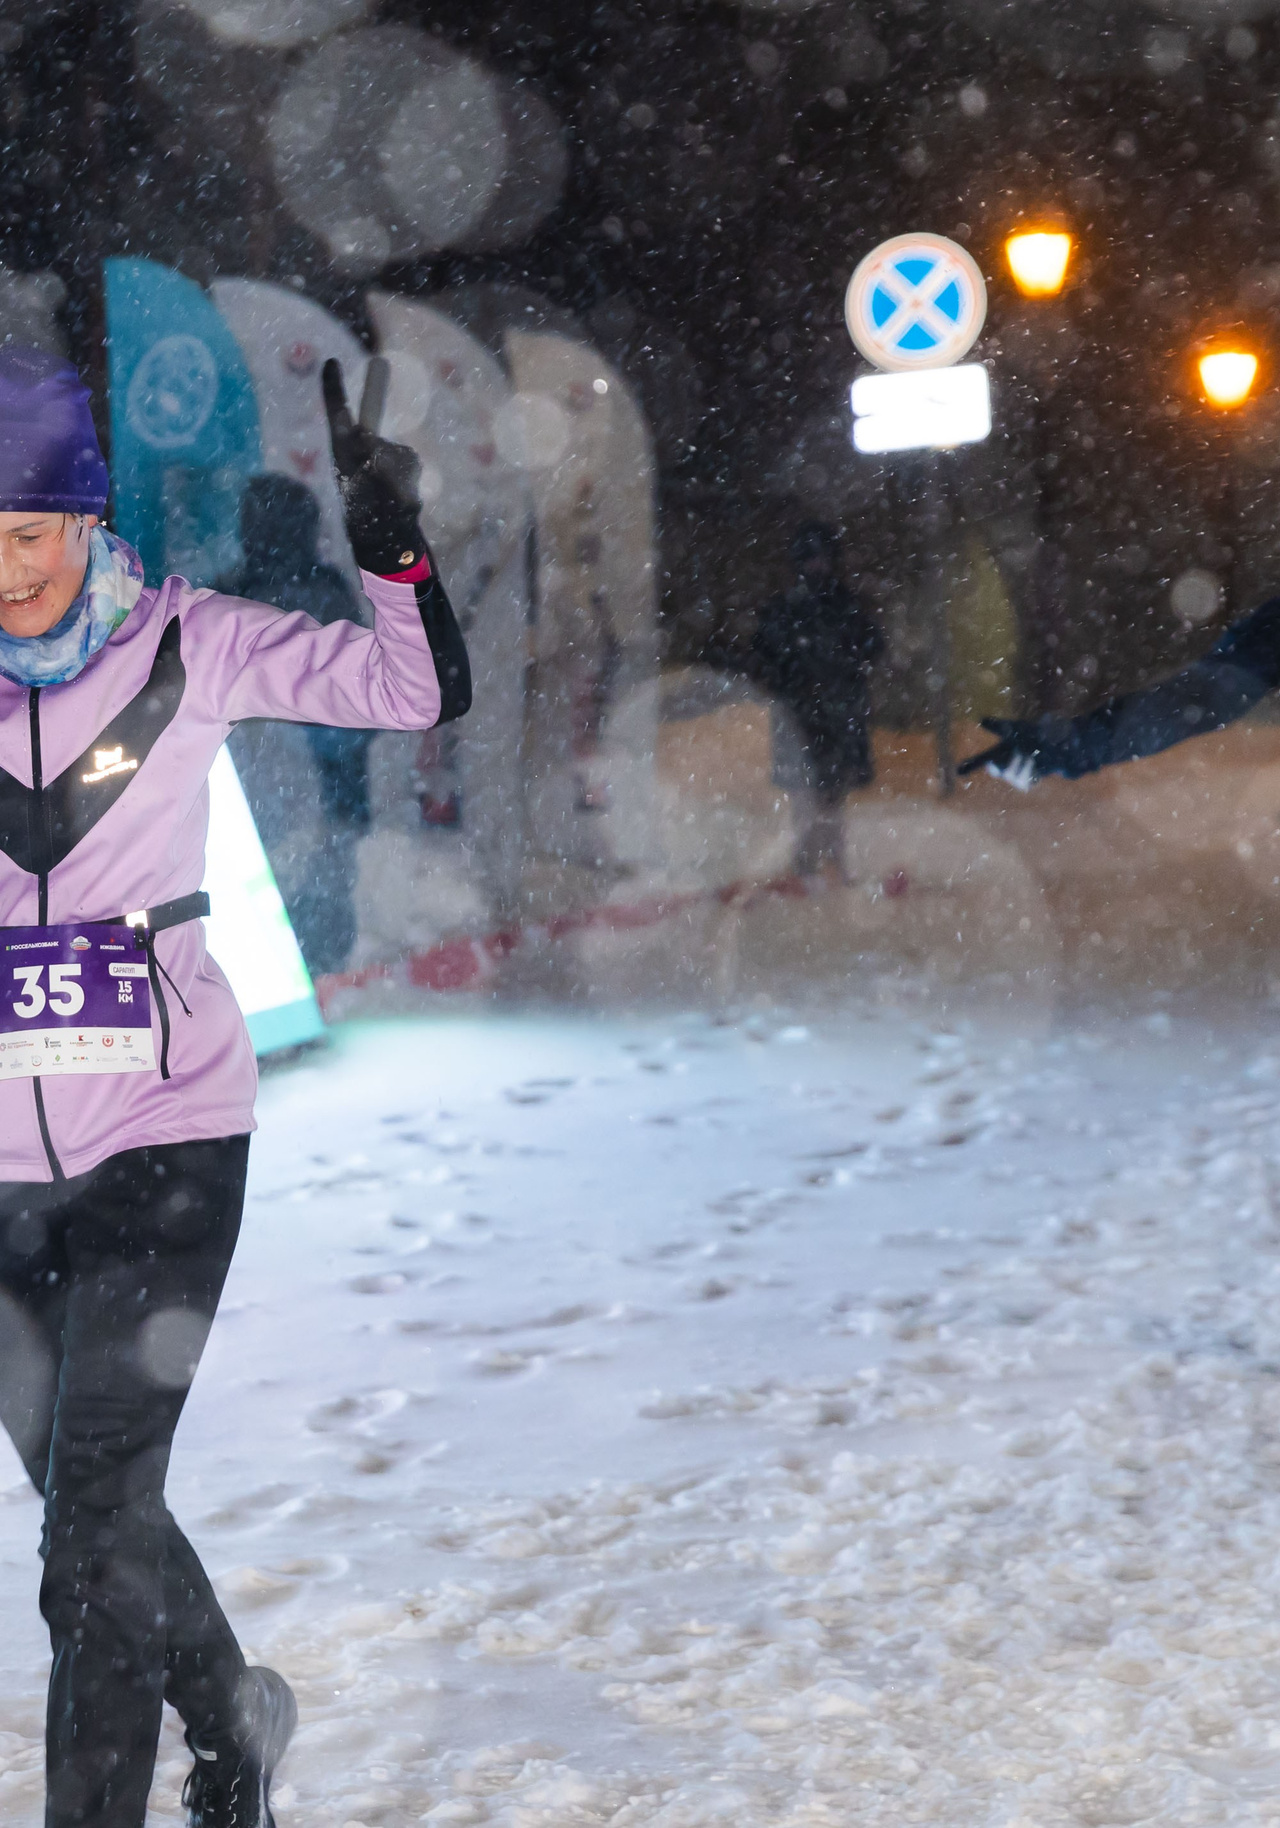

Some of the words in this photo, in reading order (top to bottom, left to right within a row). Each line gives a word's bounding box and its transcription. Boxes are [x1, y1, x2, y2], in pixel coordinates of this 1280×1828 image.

[12, 963, 85, 1019] 35
[118, 980, 132, 993] 15
[118, 993, 133, 1003] КМ
